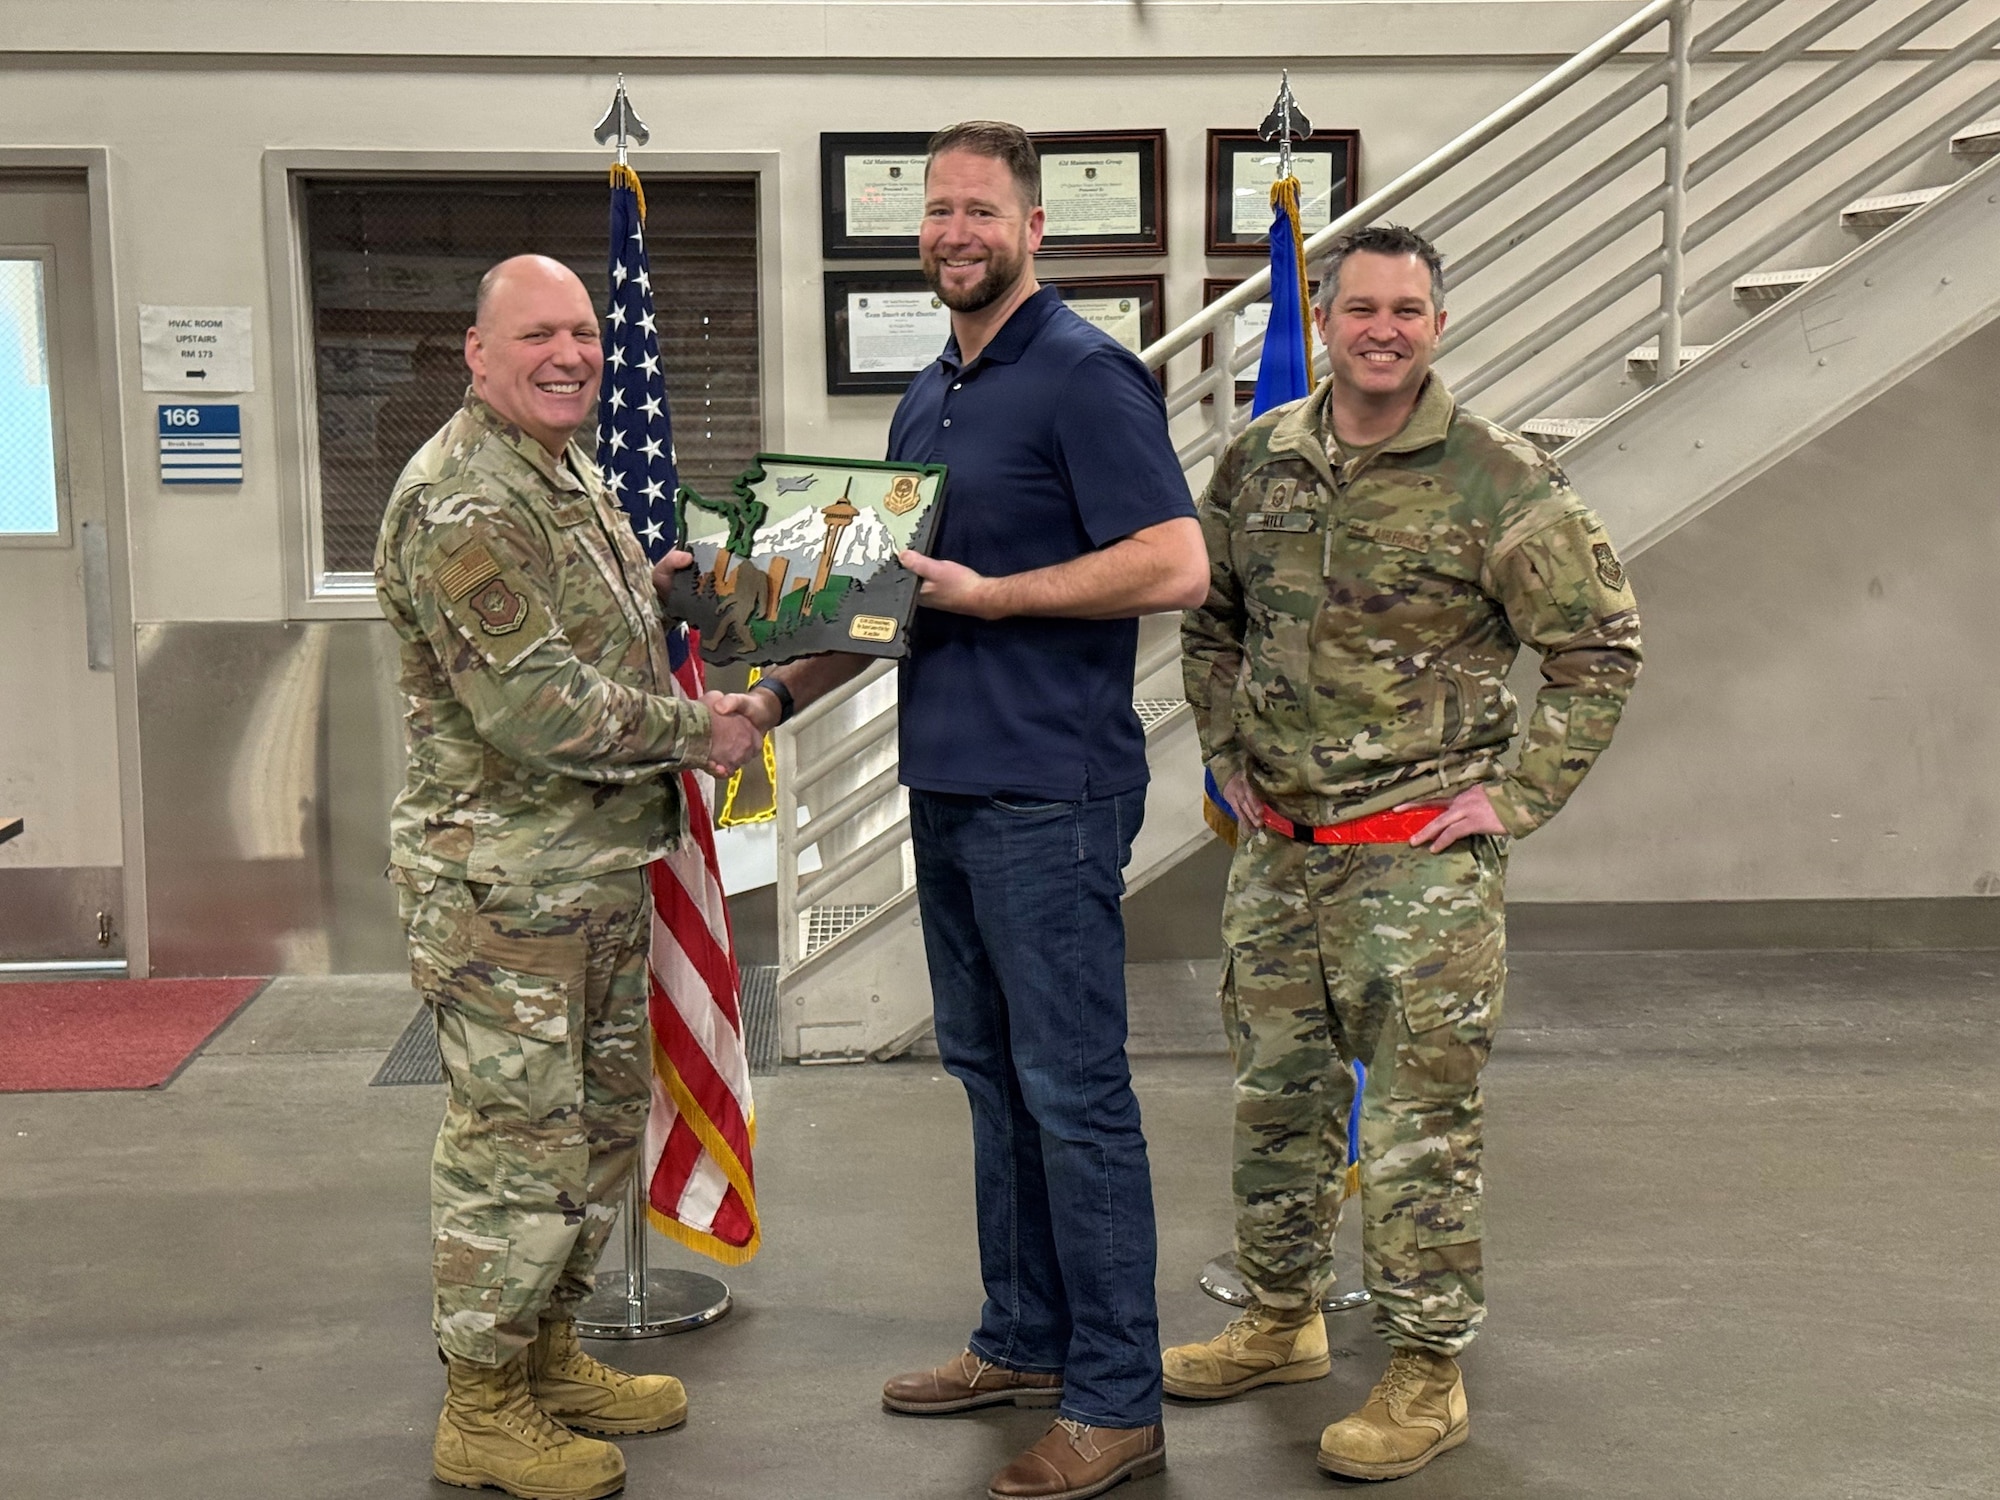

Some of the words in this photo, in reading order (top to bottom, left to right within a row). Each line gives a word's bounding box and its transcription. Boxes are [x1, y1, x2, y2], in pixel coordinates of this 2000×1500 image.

[1105, 158, 1123, 166] Group
[168, 320, 193, 328] HVAC
[194, 320, 223, 328] ROOM
[175, 335, 217, 343] UPSTAIRS
[181, 350, 195, 358] RM
[198, 350, 213, 358] 173
[162, 408, 200, 427] 166
[1263, 514, 1285, 528] HILL
